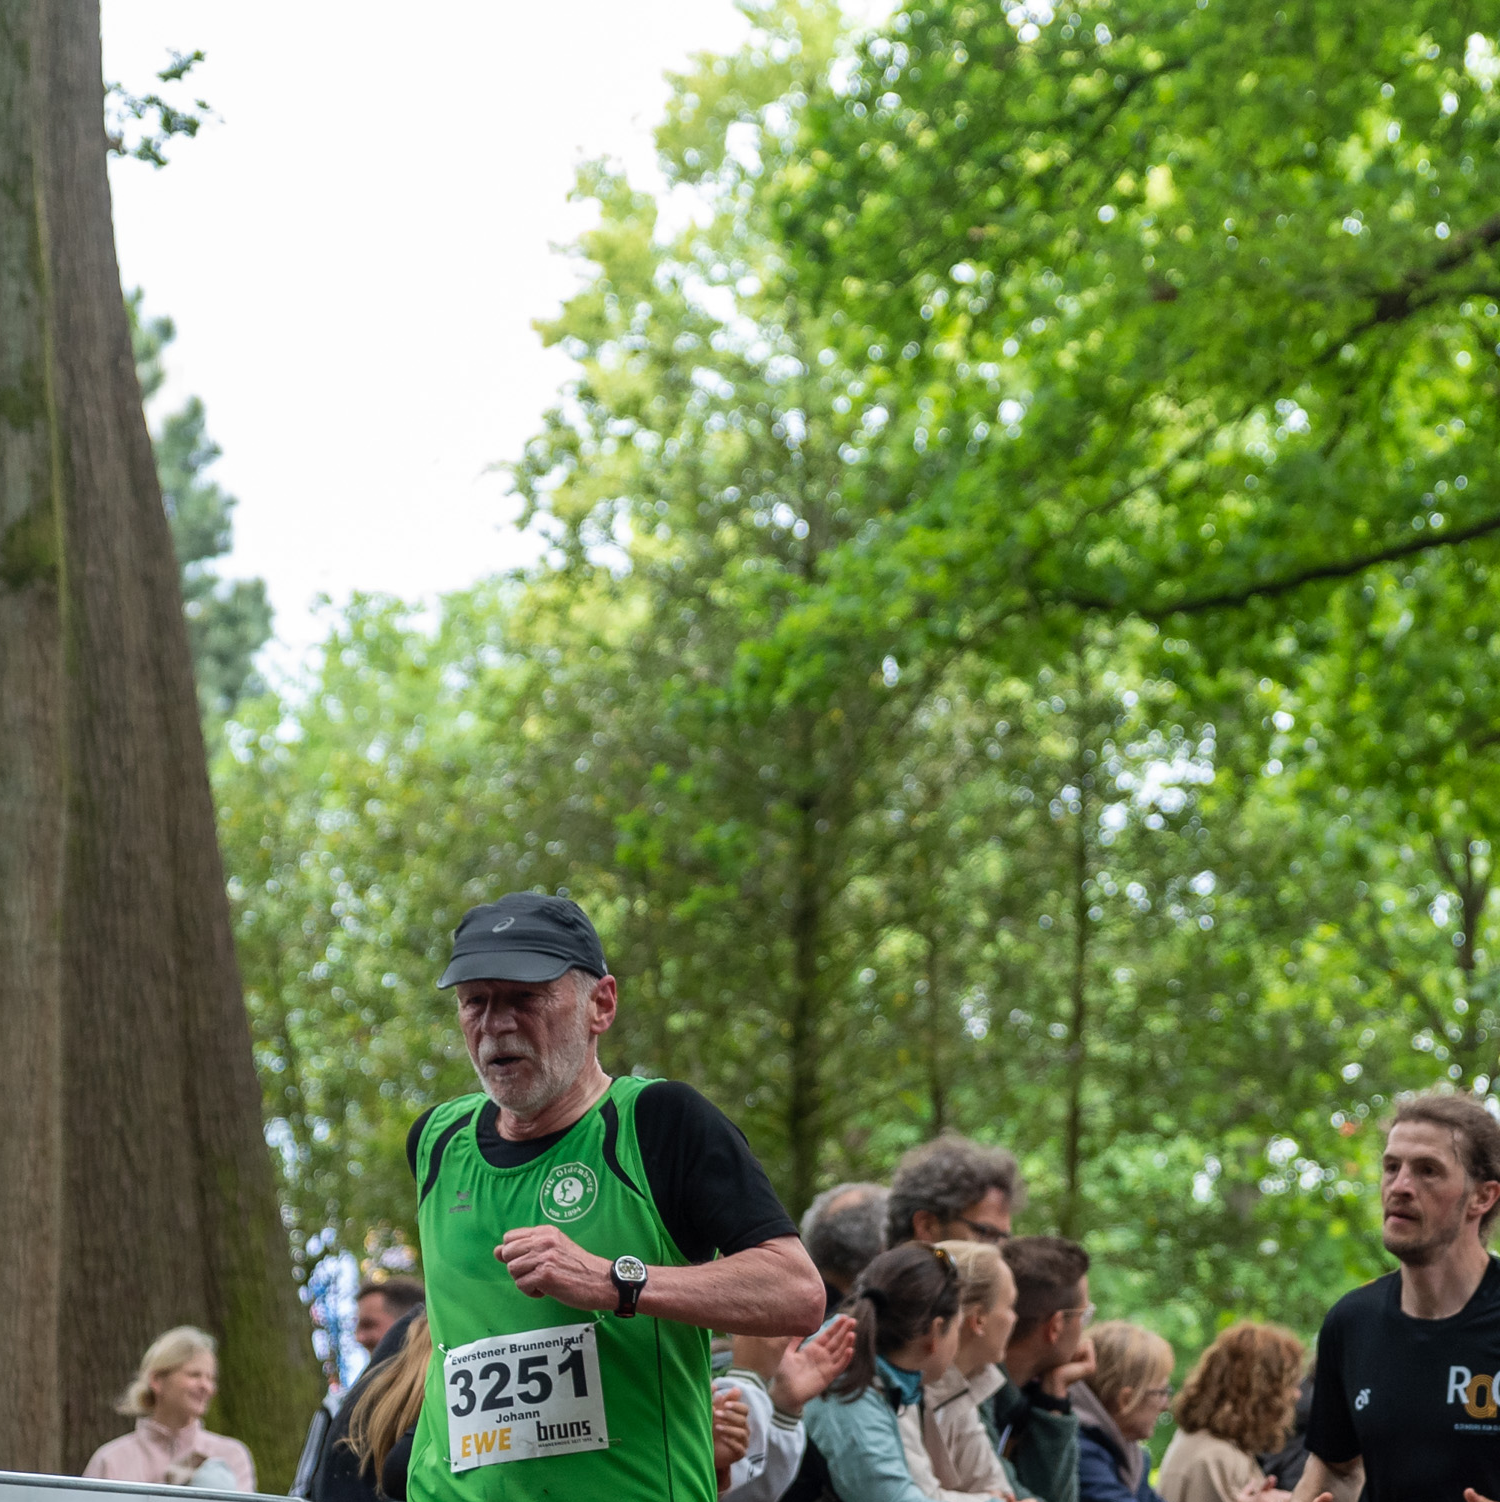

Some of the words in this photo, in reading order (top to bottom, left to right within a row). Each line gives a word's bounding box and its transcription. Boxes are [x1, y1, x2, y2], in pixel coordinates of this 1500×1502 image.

[556, 1166, 593, 1193] Oldenburg
[451, 1347, 507, 1366] Everstener
[509, 1333, 585, 1354] Brunnenlauf
[449, 1349, 589, 1418] 3251
[495, 1410, 541, 1424] Johann
[461, 1427, 512, 1458] EWE
[536, 1420, 592, 1442] bruns
